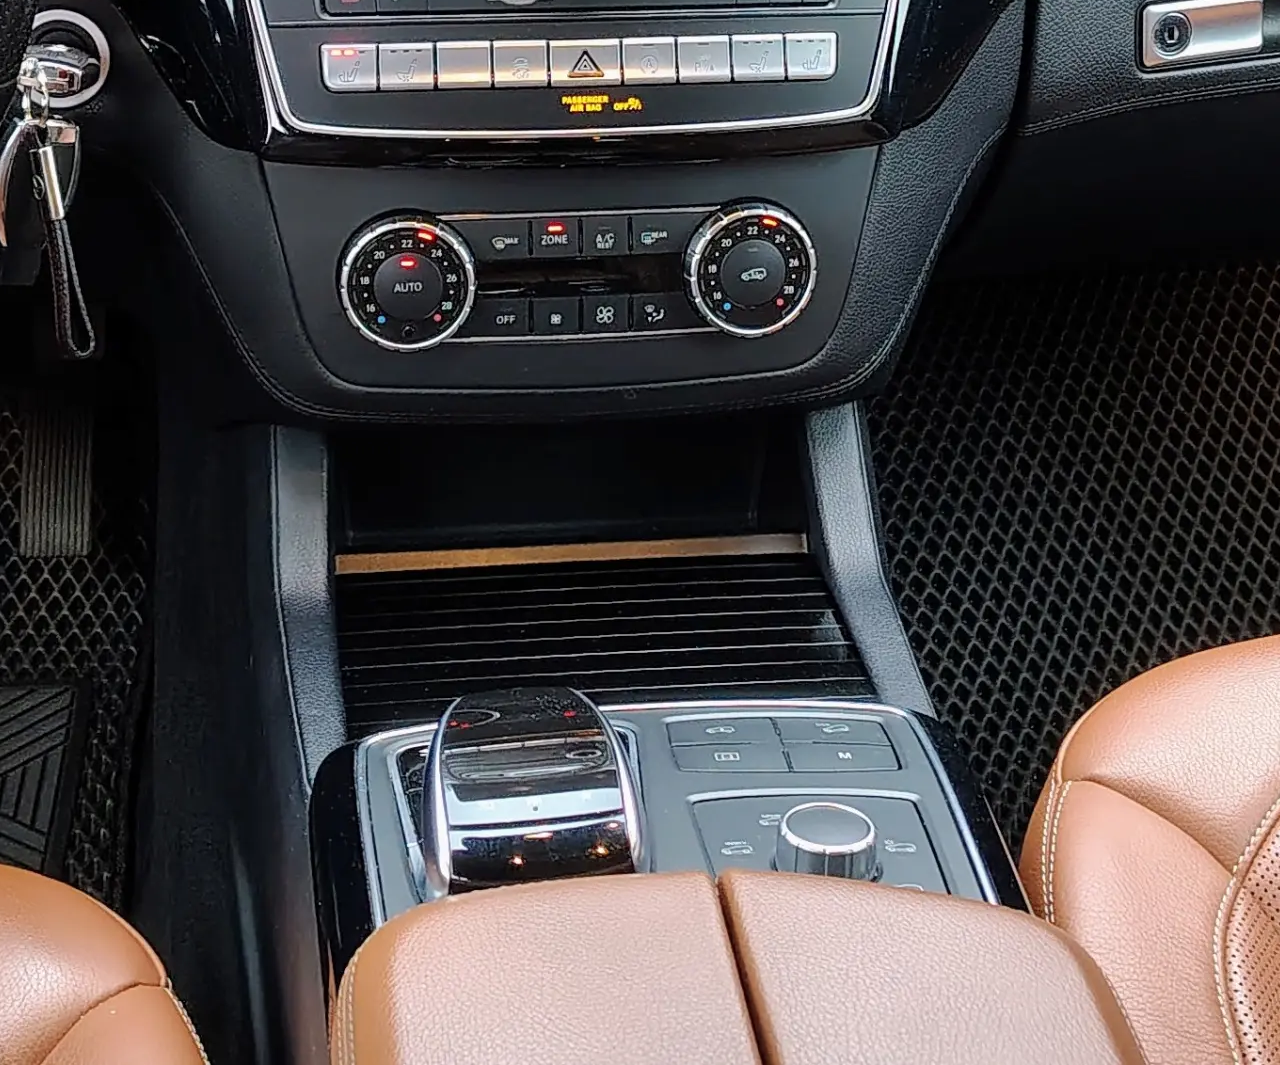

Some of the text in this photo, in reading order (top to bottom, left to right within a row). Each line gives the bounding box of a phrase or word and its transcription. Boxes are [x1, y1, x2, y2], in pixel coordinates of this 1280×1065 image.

[561, 95, 609, 104] PASSENGER
[569, 104, 584, 112] AIR
[747, 226, 759, 235] 22
[541, 235, 569, 245] ZONE
[595, 233, 615, 243] A/C
[774, 235, 786, 243] 24
[401, 240, 413, 248] 22
[721, 239, 732, 247] 20
[373, 251, 385, 260] 20
[431, 249, 443, 258] 24
[788, 259, 799, 267] 26
[360, 276, 370, 285] 18
[446, 274, 458, 283] 26
[393, 282, 423, 293] AUTO
[366, 304, 376, 312] 16
[496, 315, 517, 325] OFF
[838, 751, 853, 760] M
